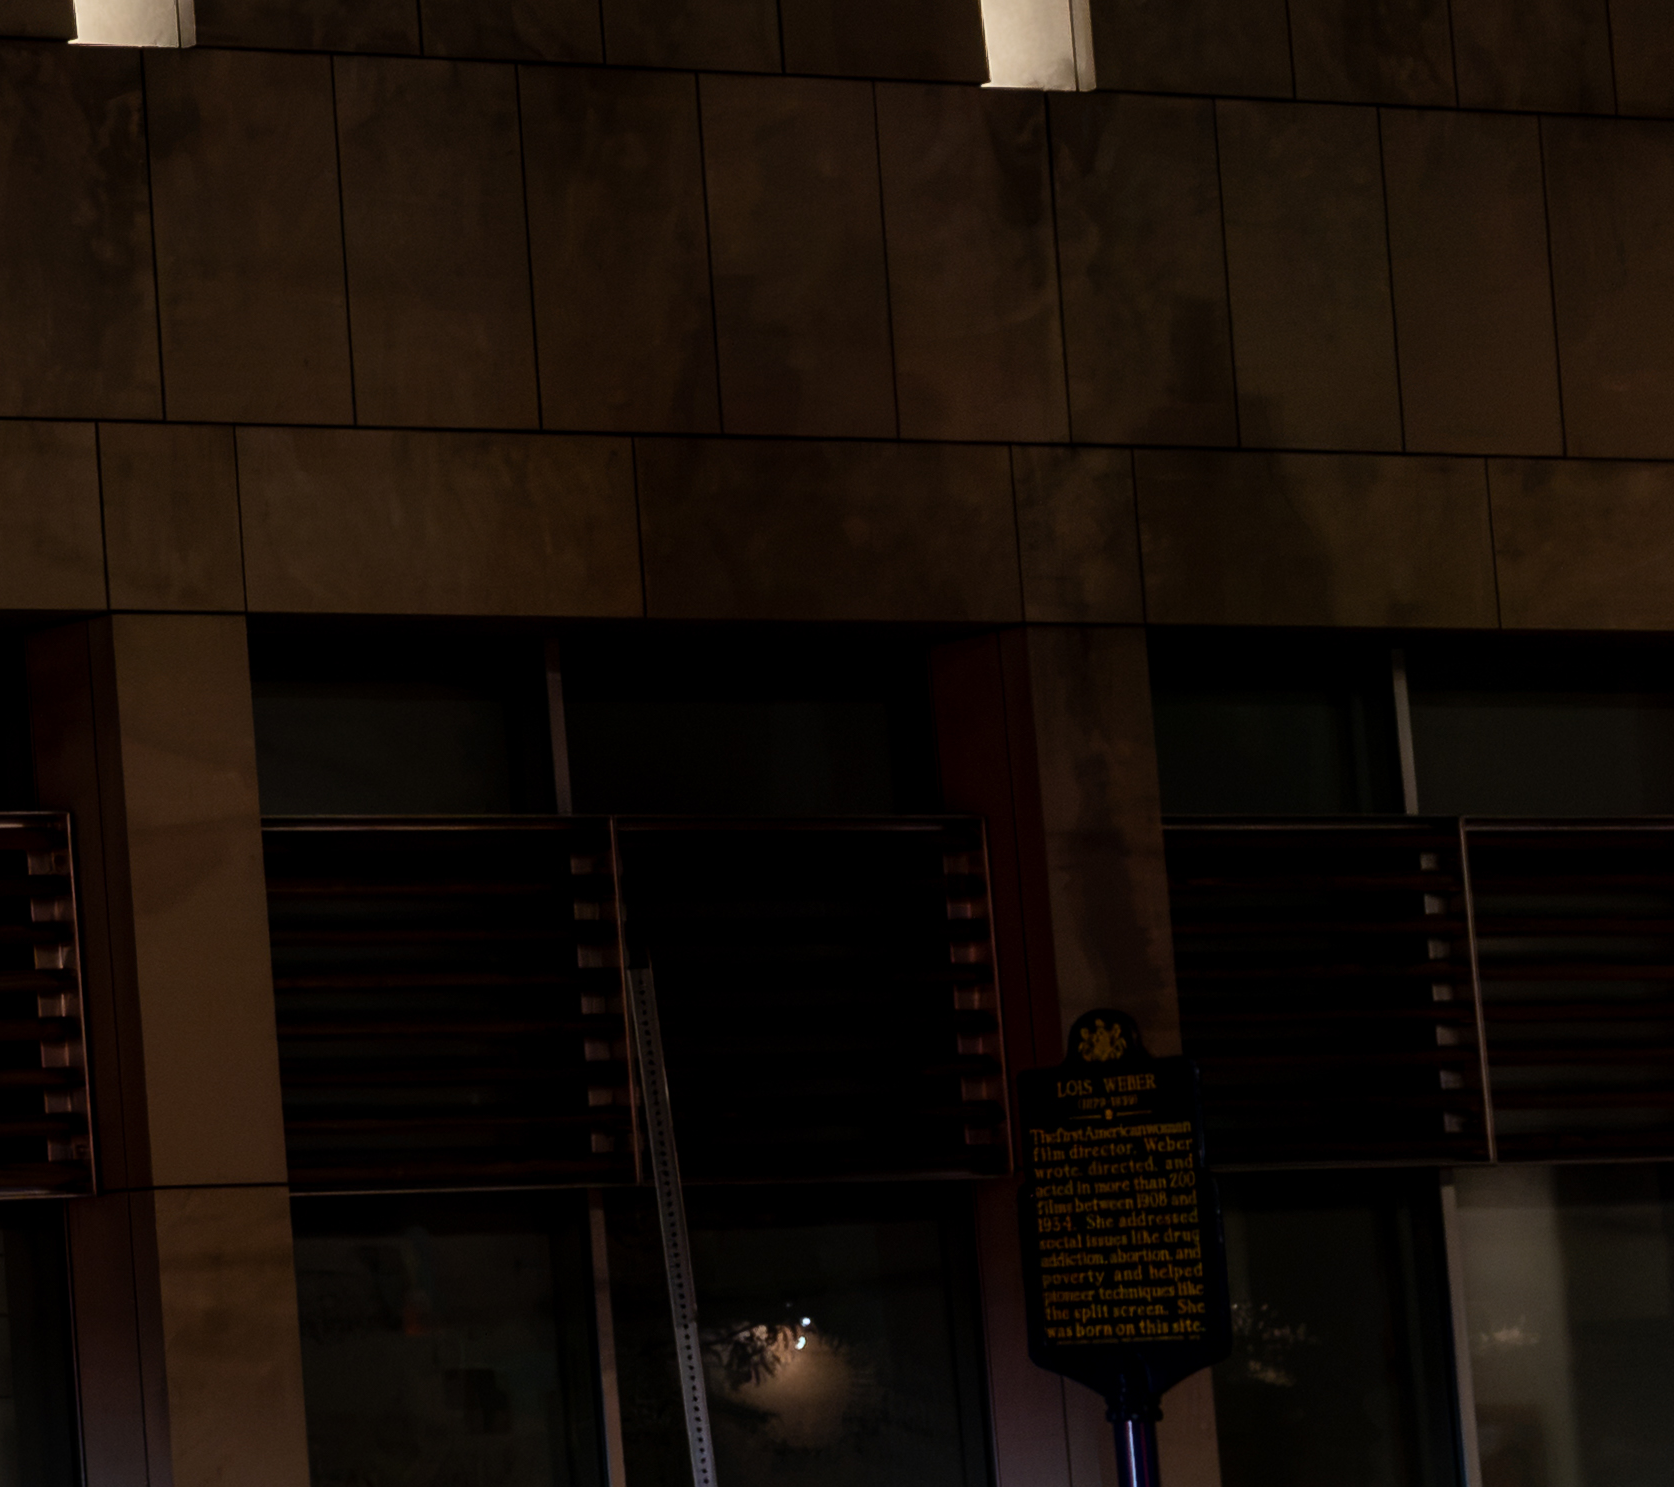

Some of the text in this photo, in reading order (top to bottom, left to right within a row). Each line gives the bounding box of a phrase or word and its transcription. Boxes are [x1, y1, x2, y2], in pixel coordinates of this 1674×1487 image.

[1056, 1072, 1157, 1098] LOIS WEBER
[1033, 1146, 1065, 1162] film
[1143, 1136, 1193, 1152] Weber
[1165, 1152, 1193, 1170] and
[1035, 1170, 1196, 1198] acted in more than 200
[1036, 1188, 1198, 1215] films between 1908 and
[1086, 1214, 1114, 1230] She
[1118, 1207, 1199, 1228] addressed
[1039, 1227, 1200, 1251] social issues like drug
[1175, 1242, 1202, 1260] and
[1041, 1262, 1203, 1289] poverty and helped
[1042, 1280, 1204, 1306] pioneer techniques like
[1045, 1305, 1070, 1321] the
[1074, 1303, 1109, 1323] split
[1177, 1298, 1206, 1315] She
[1046, 1325, 1073, 1338] was
[1075, 1321, 1113, 1338] born
[1115, 1322, 1136, 1336] on
[1138, 1319, 1169, 1335] this
